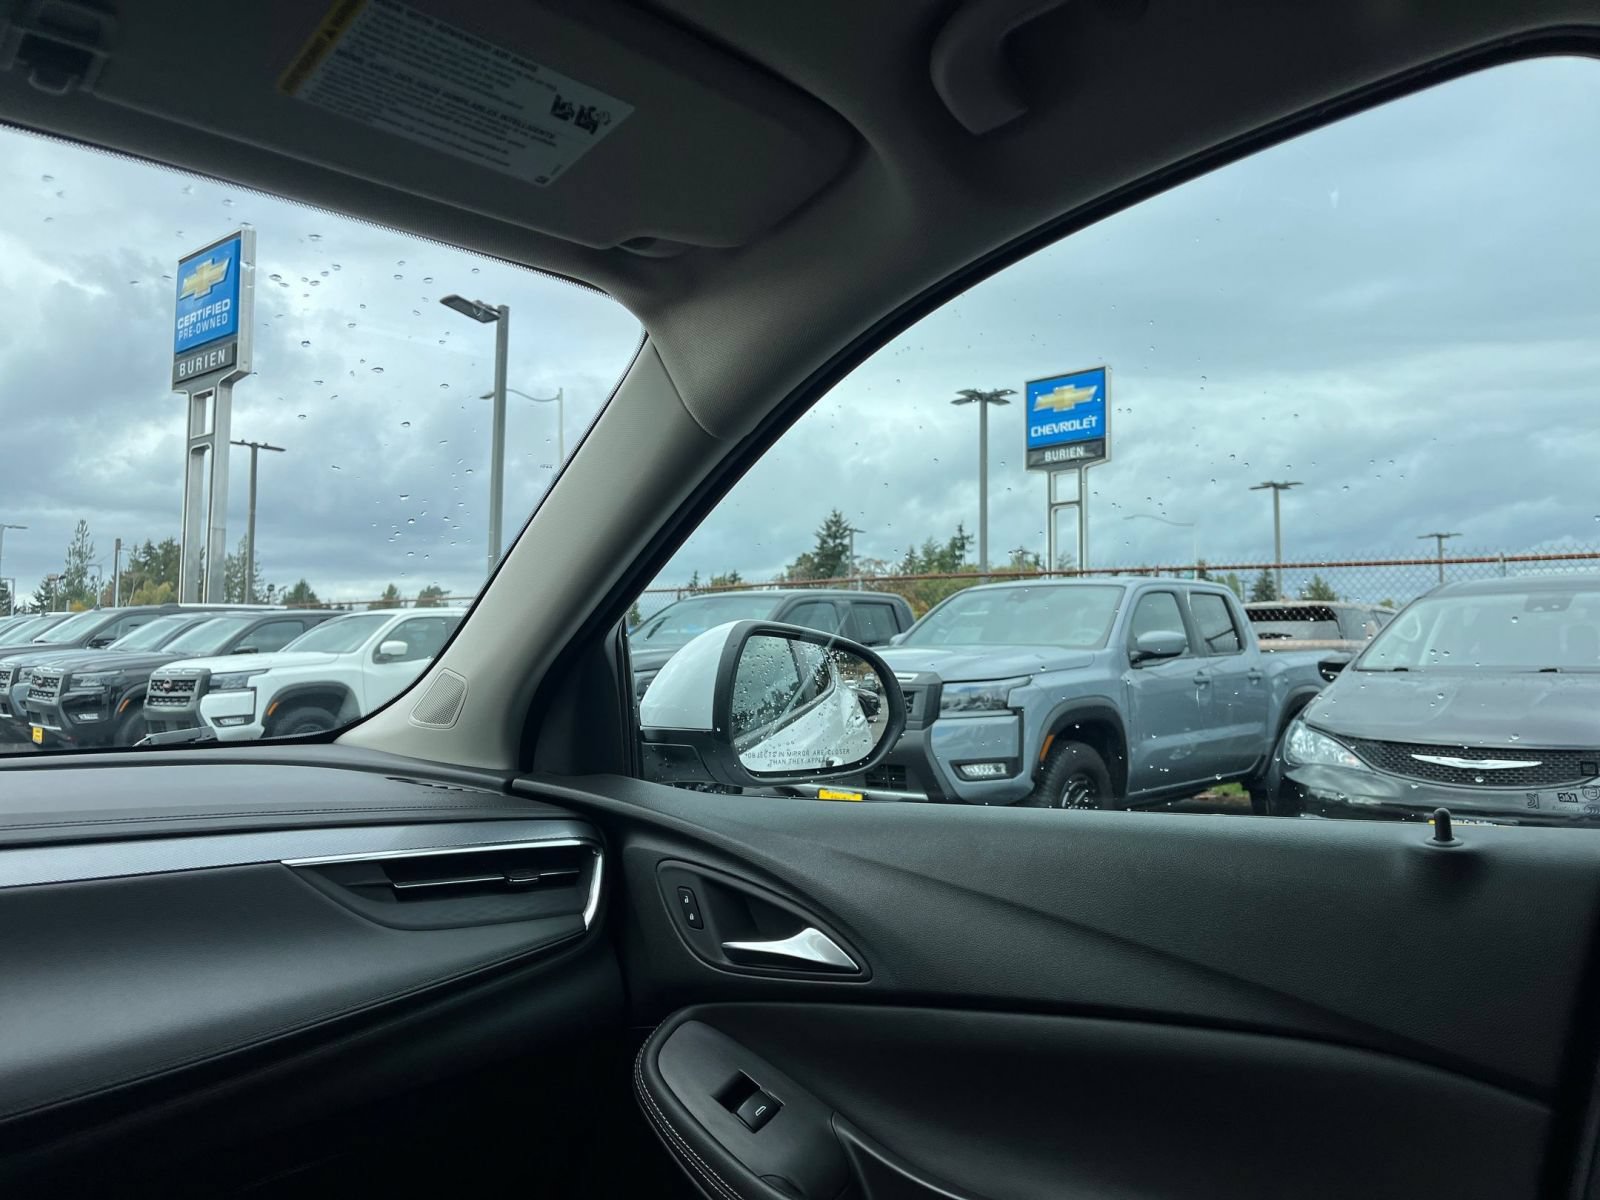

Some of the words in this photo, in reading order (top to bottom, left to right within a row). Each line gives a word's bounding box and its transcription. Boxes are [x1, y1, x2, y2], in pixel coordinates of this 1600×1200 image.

[177, 299, 230, 330] CERTIFIED
[178, 313, 228, 342] PRE-OWNED
[179, 349, 225, 377] BURIEN
[1030, 416, 1097, 438] CHEVROLET
[1044, 446, 1084, 462] BURIEN
[812, 749, 824, 757] ARE
[827, 748, 850, 756] CLOSER
